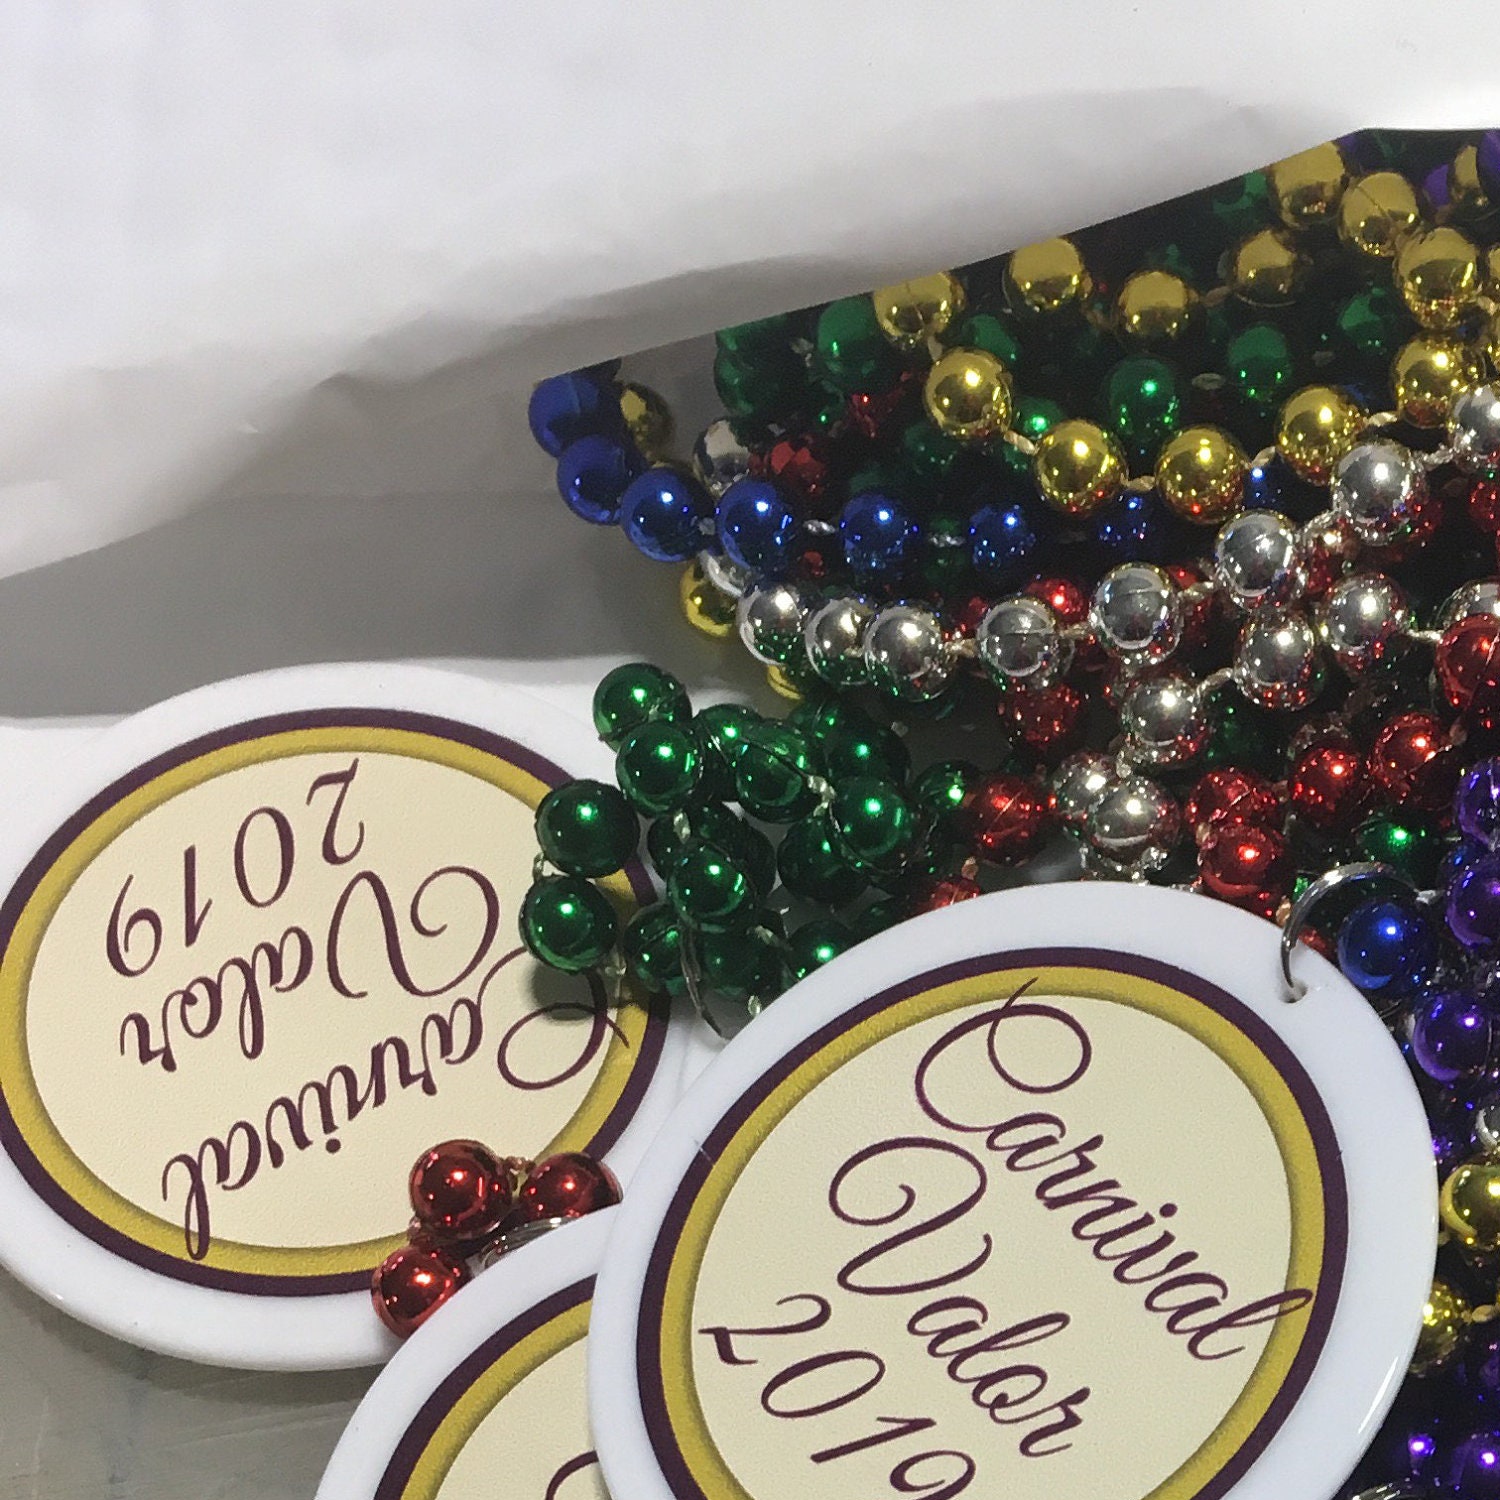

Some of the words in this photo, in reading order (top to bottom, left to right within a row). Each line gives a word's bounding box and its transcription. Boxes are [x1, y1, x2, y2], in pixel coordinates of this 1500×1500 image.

[107, 757, 365, 977] 2019
[120, 865, 499, 1072] Valor
[162, 946, 630, 1260] Carnival
[915, 976, 1313, 1360] Carnival
[828, 1137, 1091, 1457] Valor
